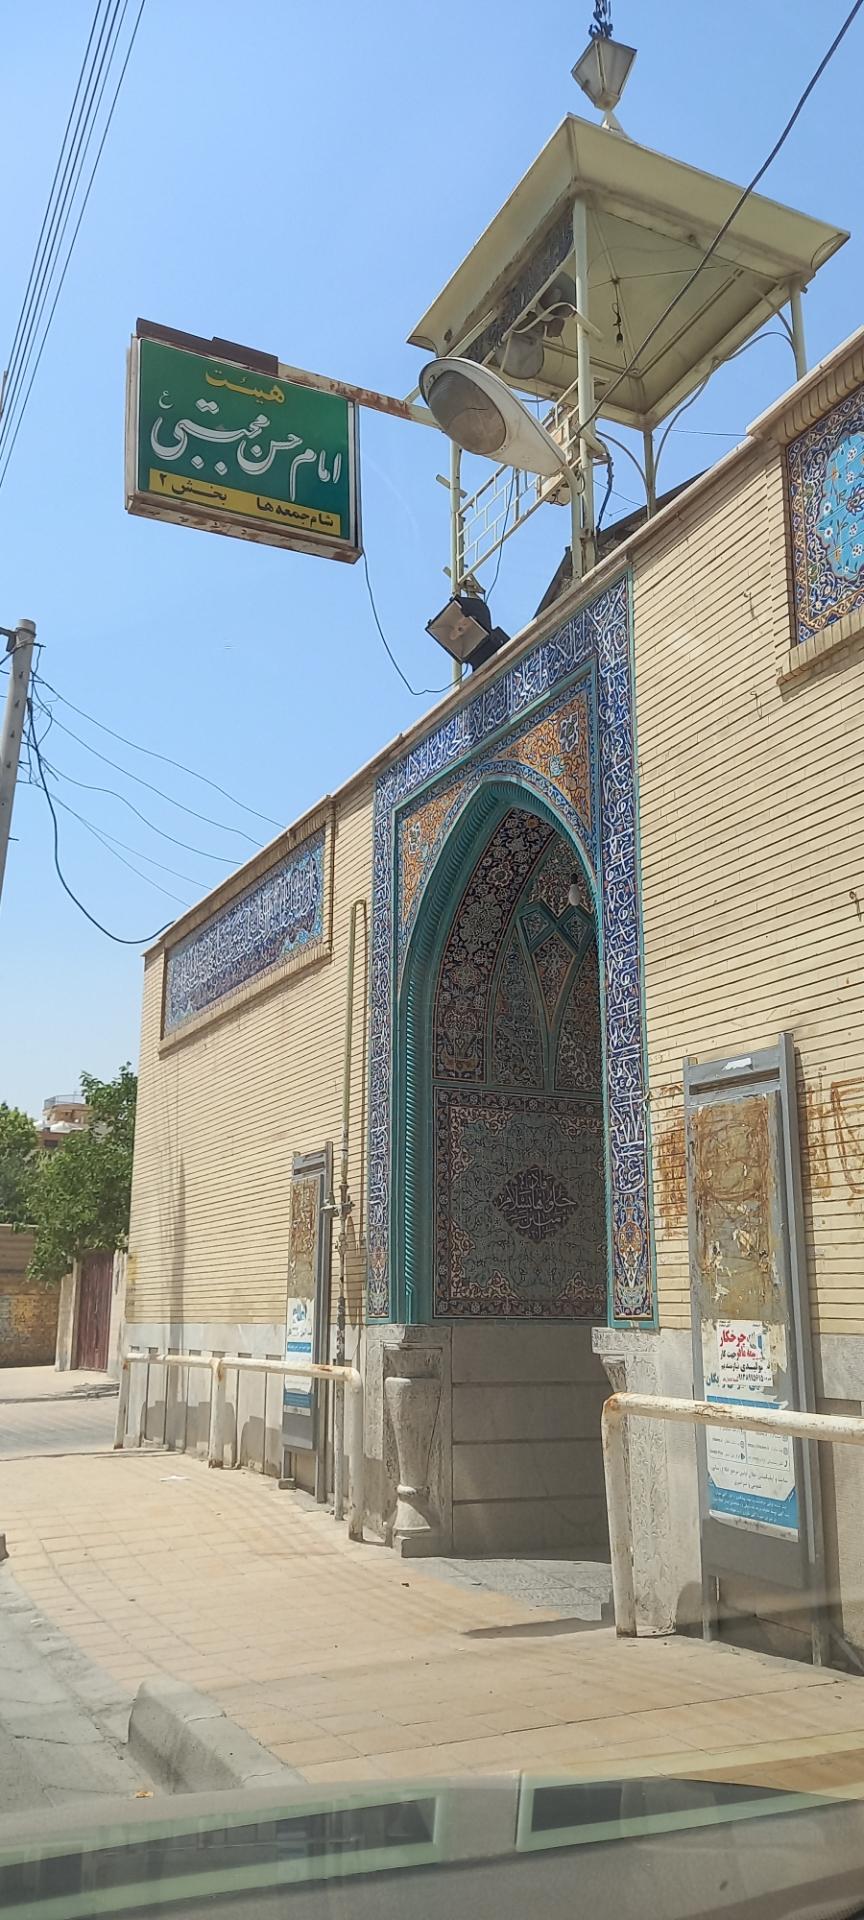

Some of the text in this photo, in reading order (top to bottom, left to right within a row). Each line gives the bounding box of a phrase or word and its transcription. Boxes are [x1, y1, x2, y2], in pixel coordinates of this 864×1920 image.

[151, 398, 271, 476] مجتبی
[236, 433, 303, 475] حسن
[289, 448, 342, 502] امام
[171, 479, 227, 506] بخش
[275, 504, 310, 525] جمعه
[309, 512, 334, 528] شام
